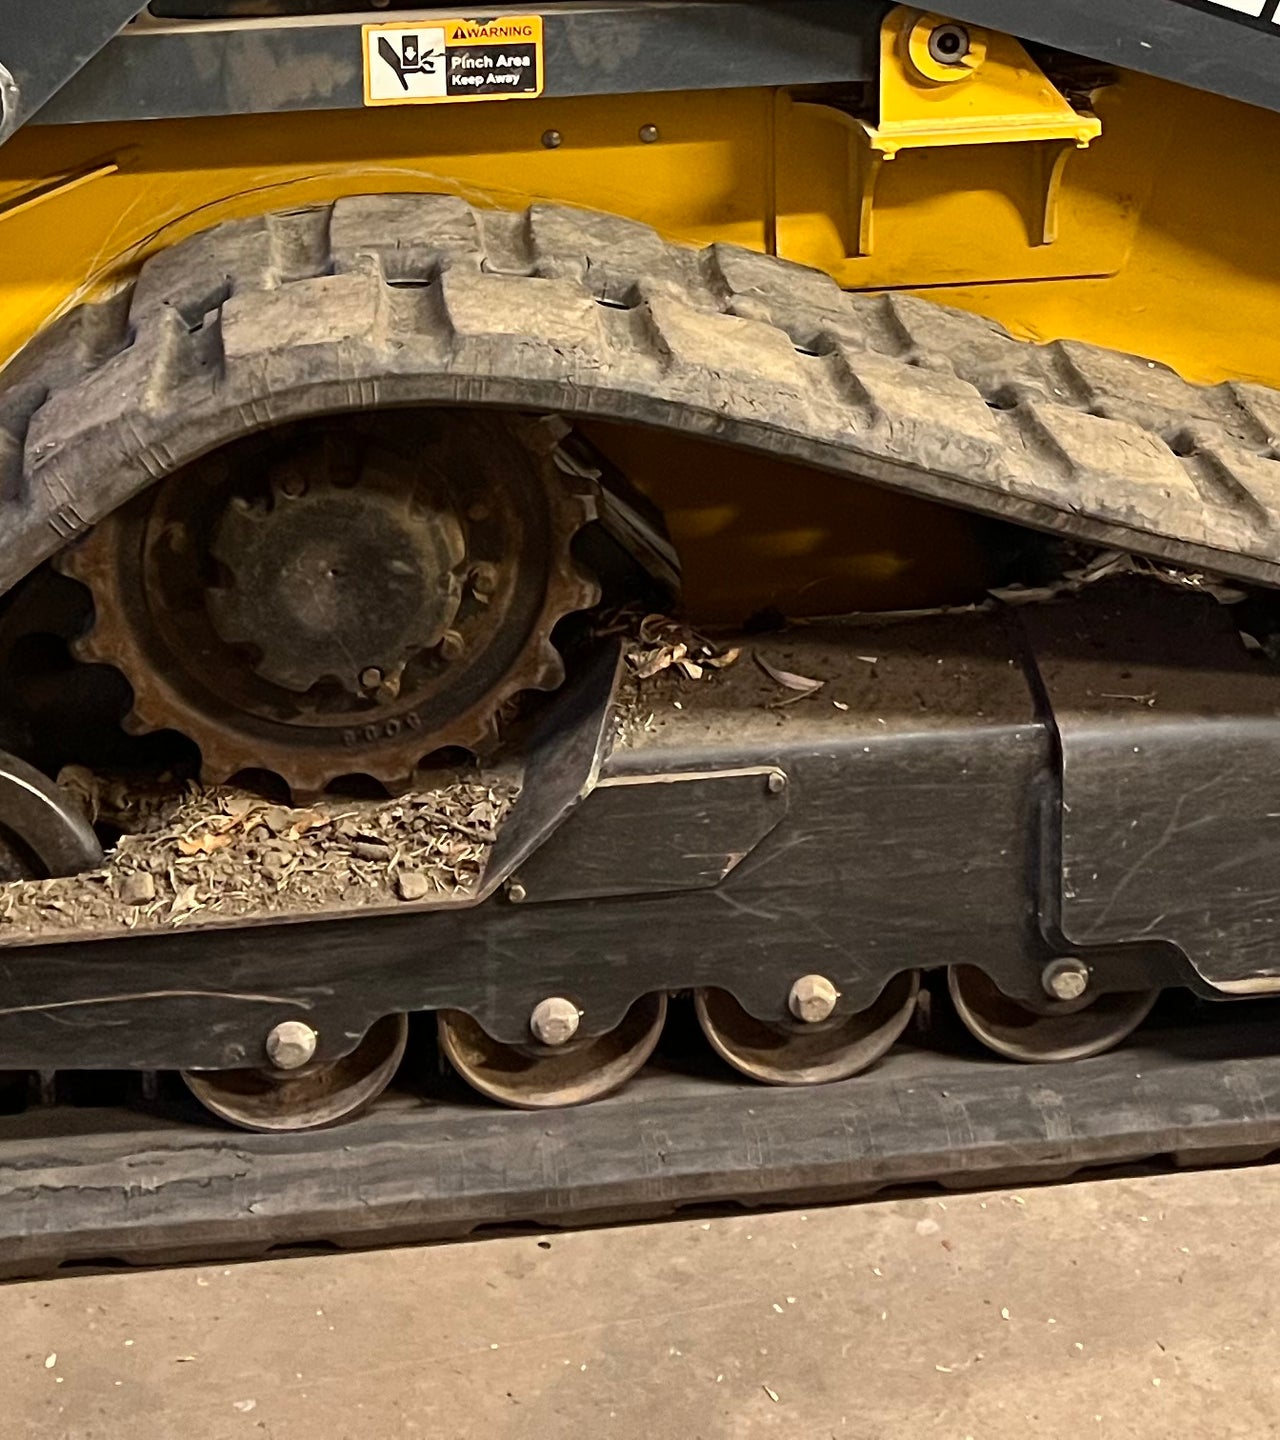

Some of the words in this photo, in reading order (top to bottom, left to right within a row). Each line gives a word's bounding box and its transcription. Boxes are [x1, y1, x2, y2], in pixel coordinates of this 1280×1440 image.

[466, 26, 532, 39] WARNING
[451, 54, 493, 69] Pinch
[495, 54, 531, 68] Area
[452, 73, 484, 86] Keep
[486, 72, 520, 86] Away
